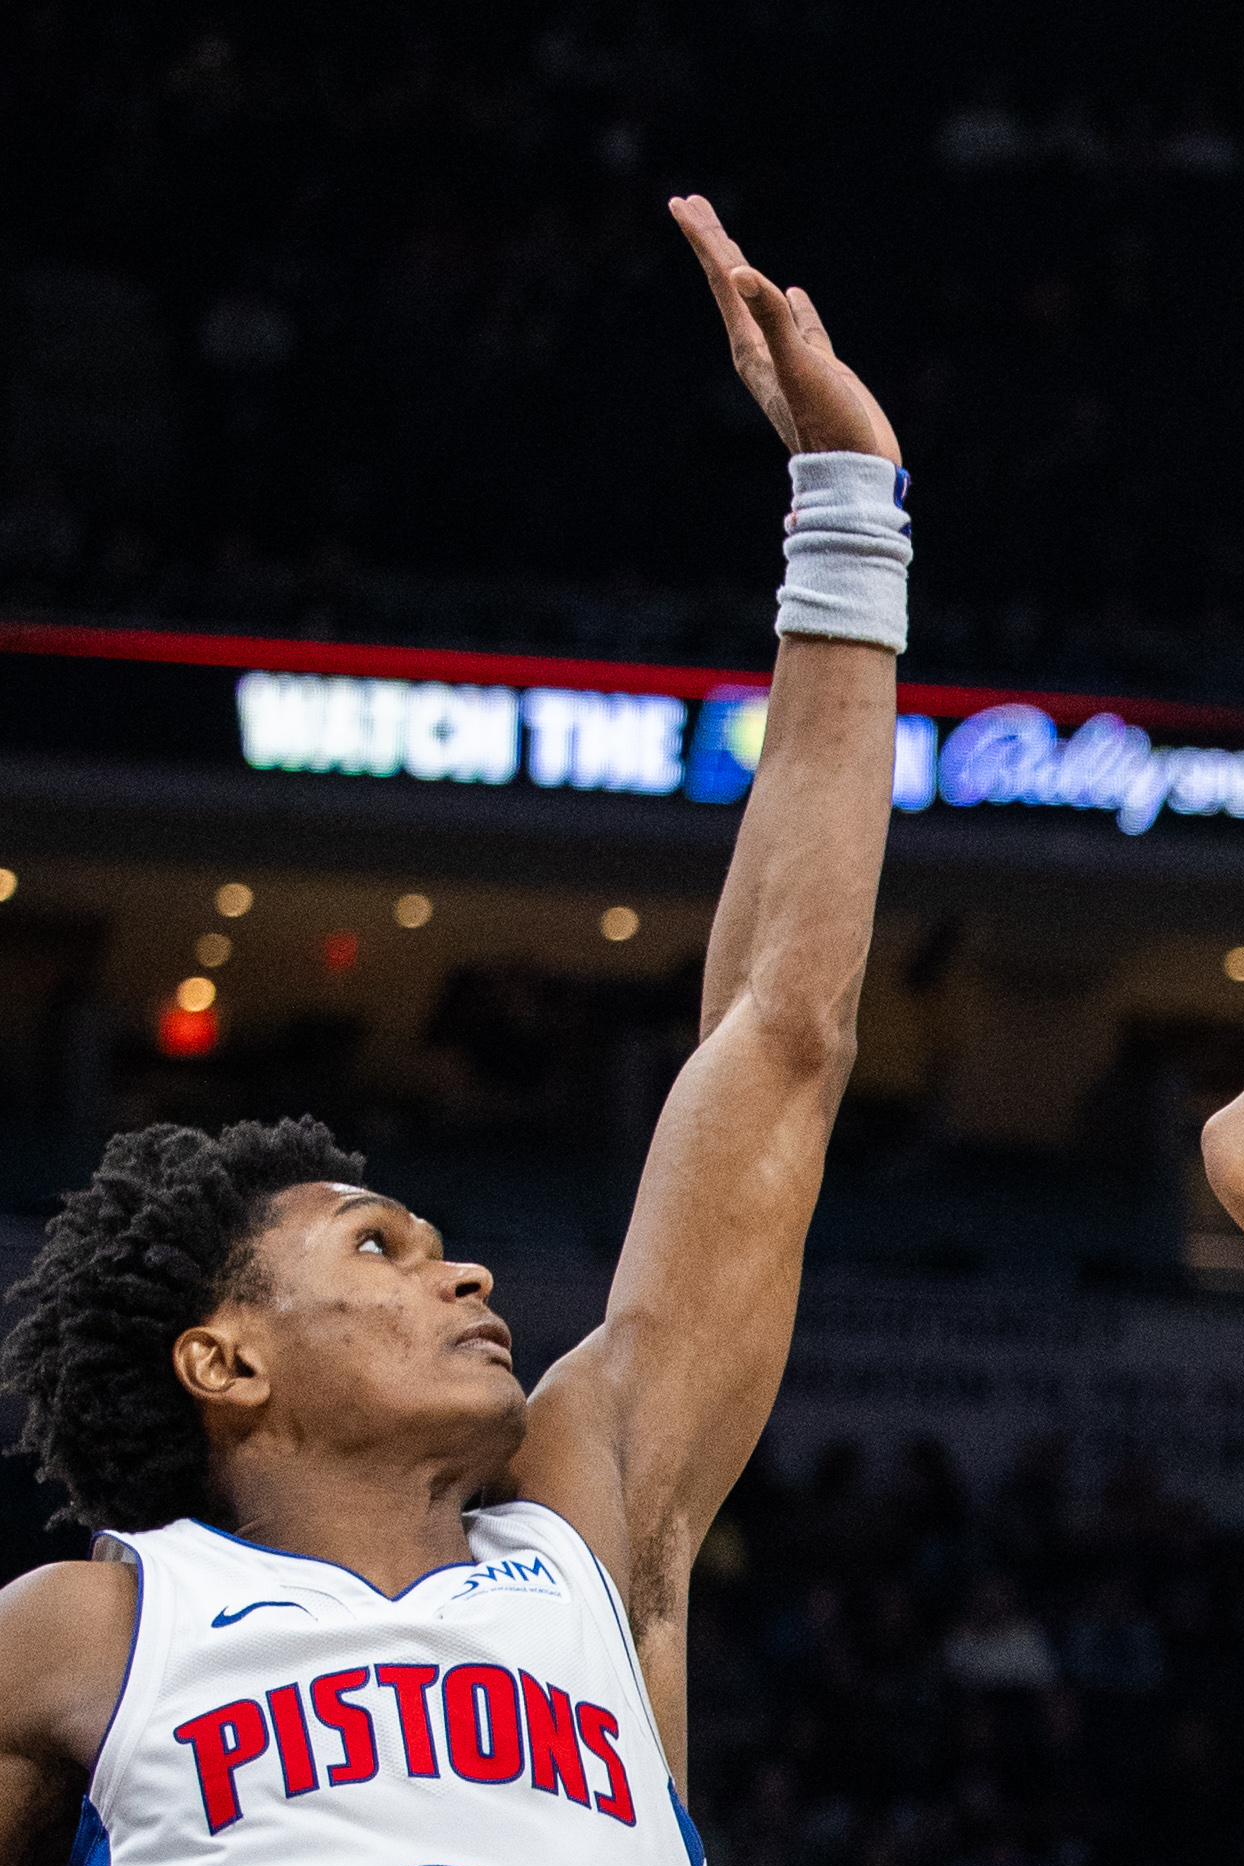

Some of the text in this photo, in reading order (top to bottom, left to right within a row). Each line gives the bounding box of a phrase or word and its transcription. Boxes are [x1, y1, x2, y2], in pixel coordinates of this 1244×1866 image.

[236, 669, 520, 783] WATCH
[523, 687, 687, 795] THE
[940, 703, 1165, 834] Bally
[174, 1662, 637, 1836] PISTONS
